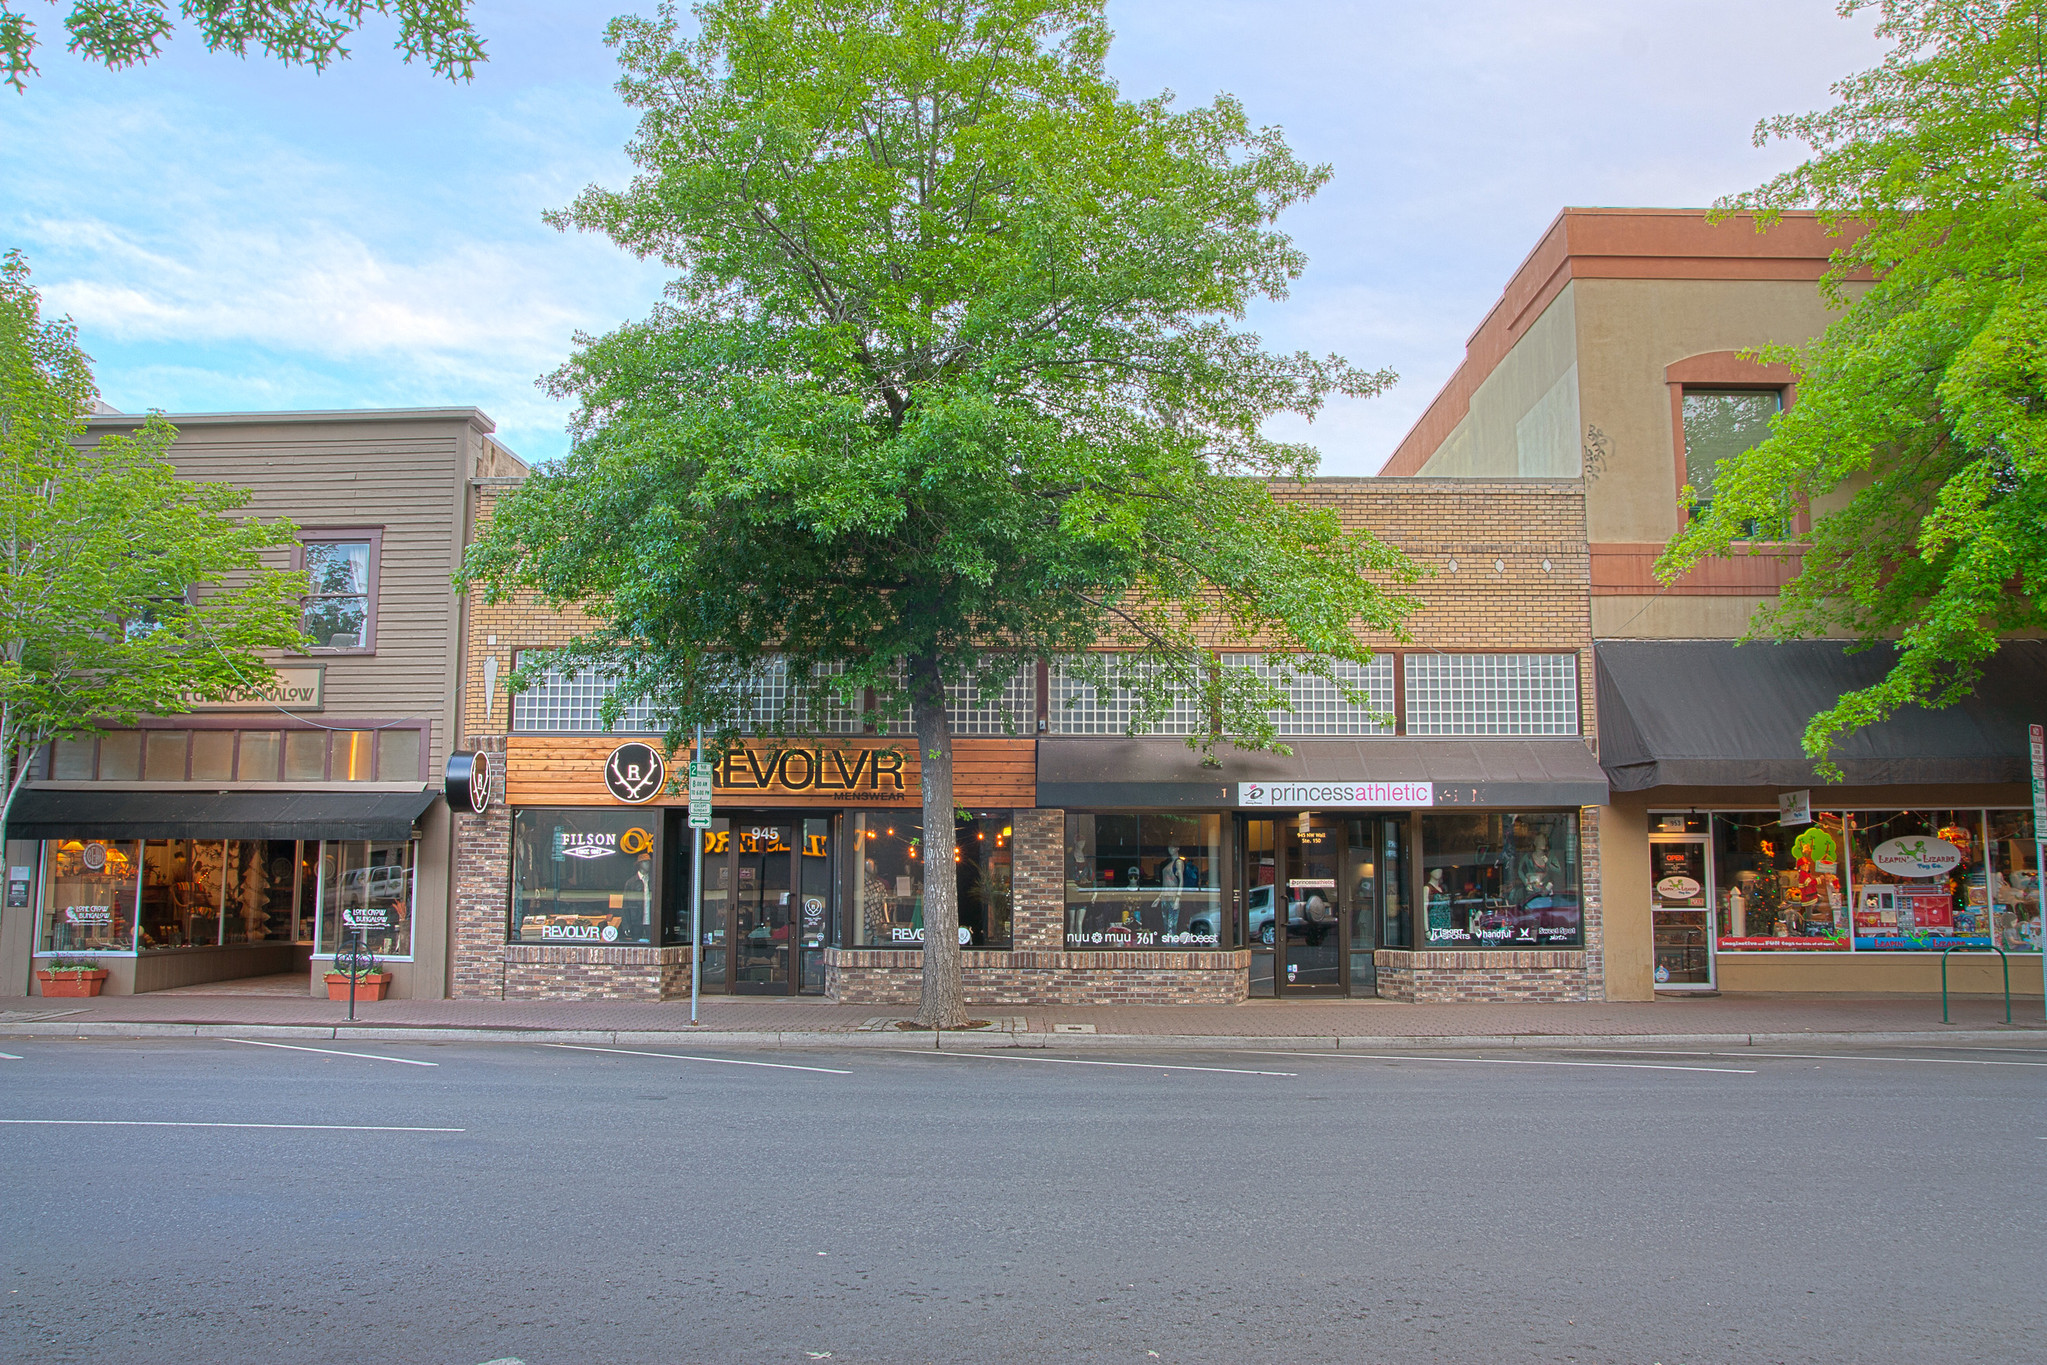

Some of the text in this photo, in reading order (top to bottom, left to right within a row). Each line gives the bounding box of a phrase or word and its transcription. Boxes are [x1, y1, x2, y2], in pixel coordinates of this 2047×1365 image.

[691, 764, 697, 775] 2
[833, 792, 905, 801] MENSWEAR
[1271, 783, 1428, 805] princessathletic
[561, 833, 617, 846] FILSON
[751, 827, 779, 840] 945
[542, 925, 600, 938] REVOLVR
[892, 927, 924, 940] REV
[1066, 932, 1132, 943] nuu muu
[1482, 928, 1513, 940] handful
